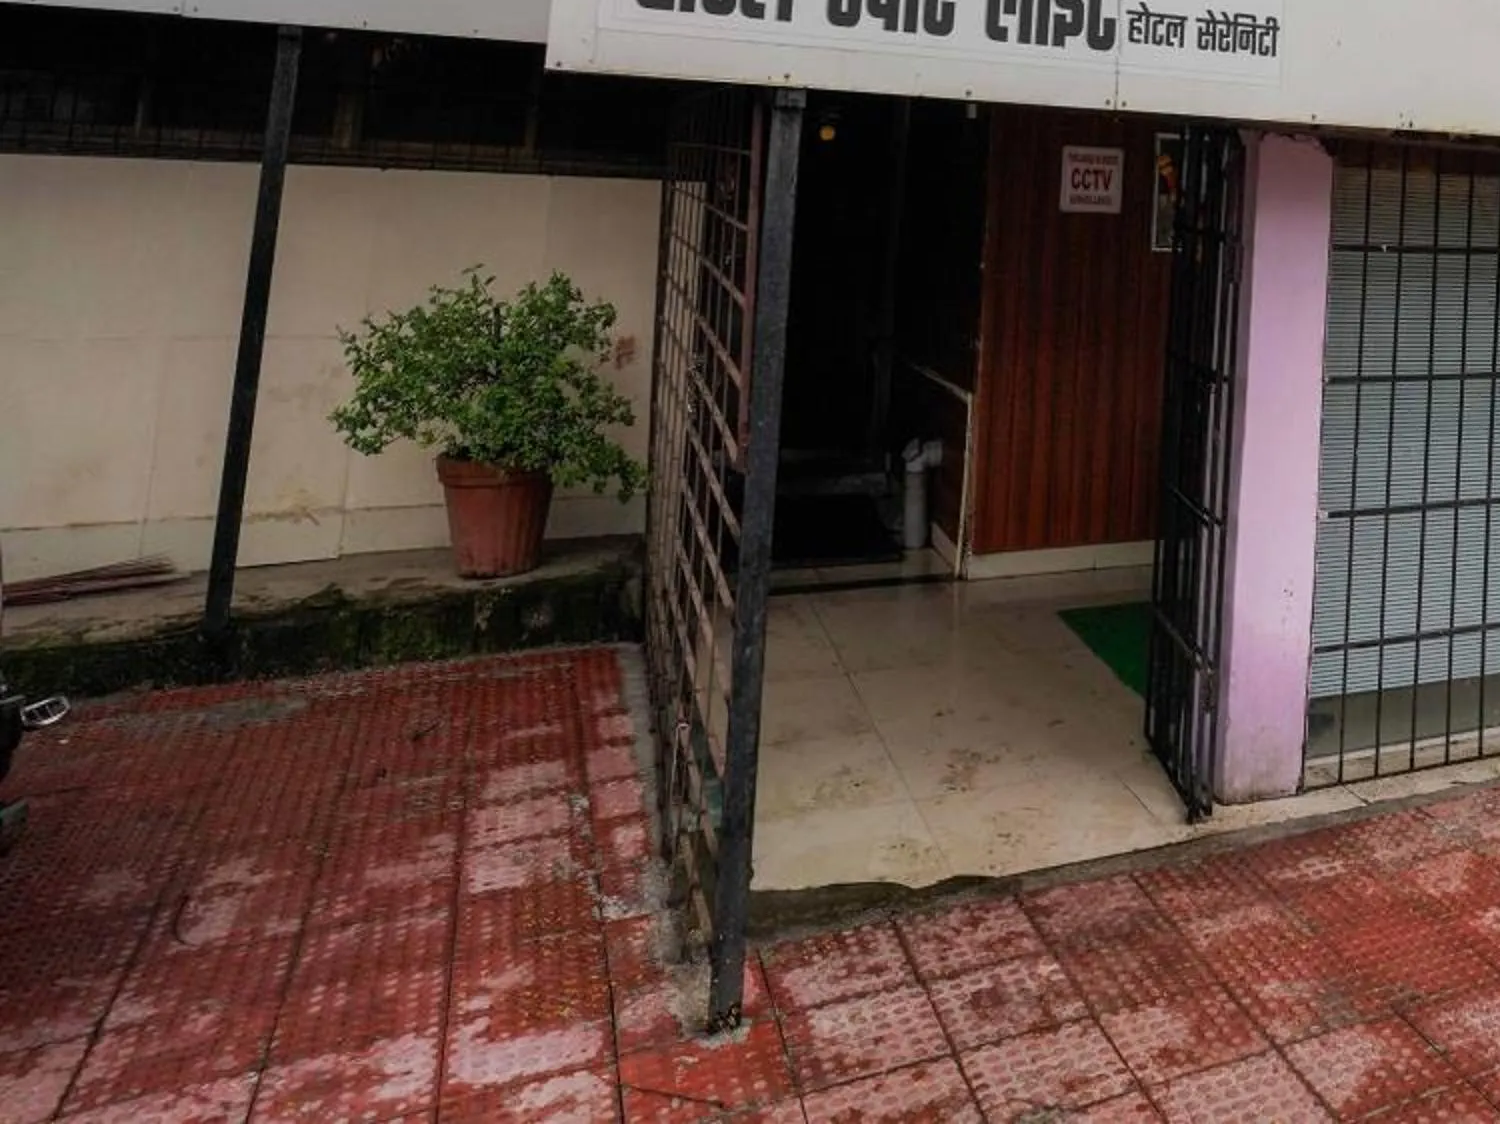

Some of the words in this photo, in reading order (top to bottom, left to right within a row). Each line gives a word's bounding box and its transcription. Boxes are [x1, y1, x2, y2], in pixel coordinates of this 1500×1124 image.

[1126, 2, 1188, 48] होटल
[1196, 10, 1281, 57] सेरेनिटी
[1071, 168, 1113, 192] CCTV
